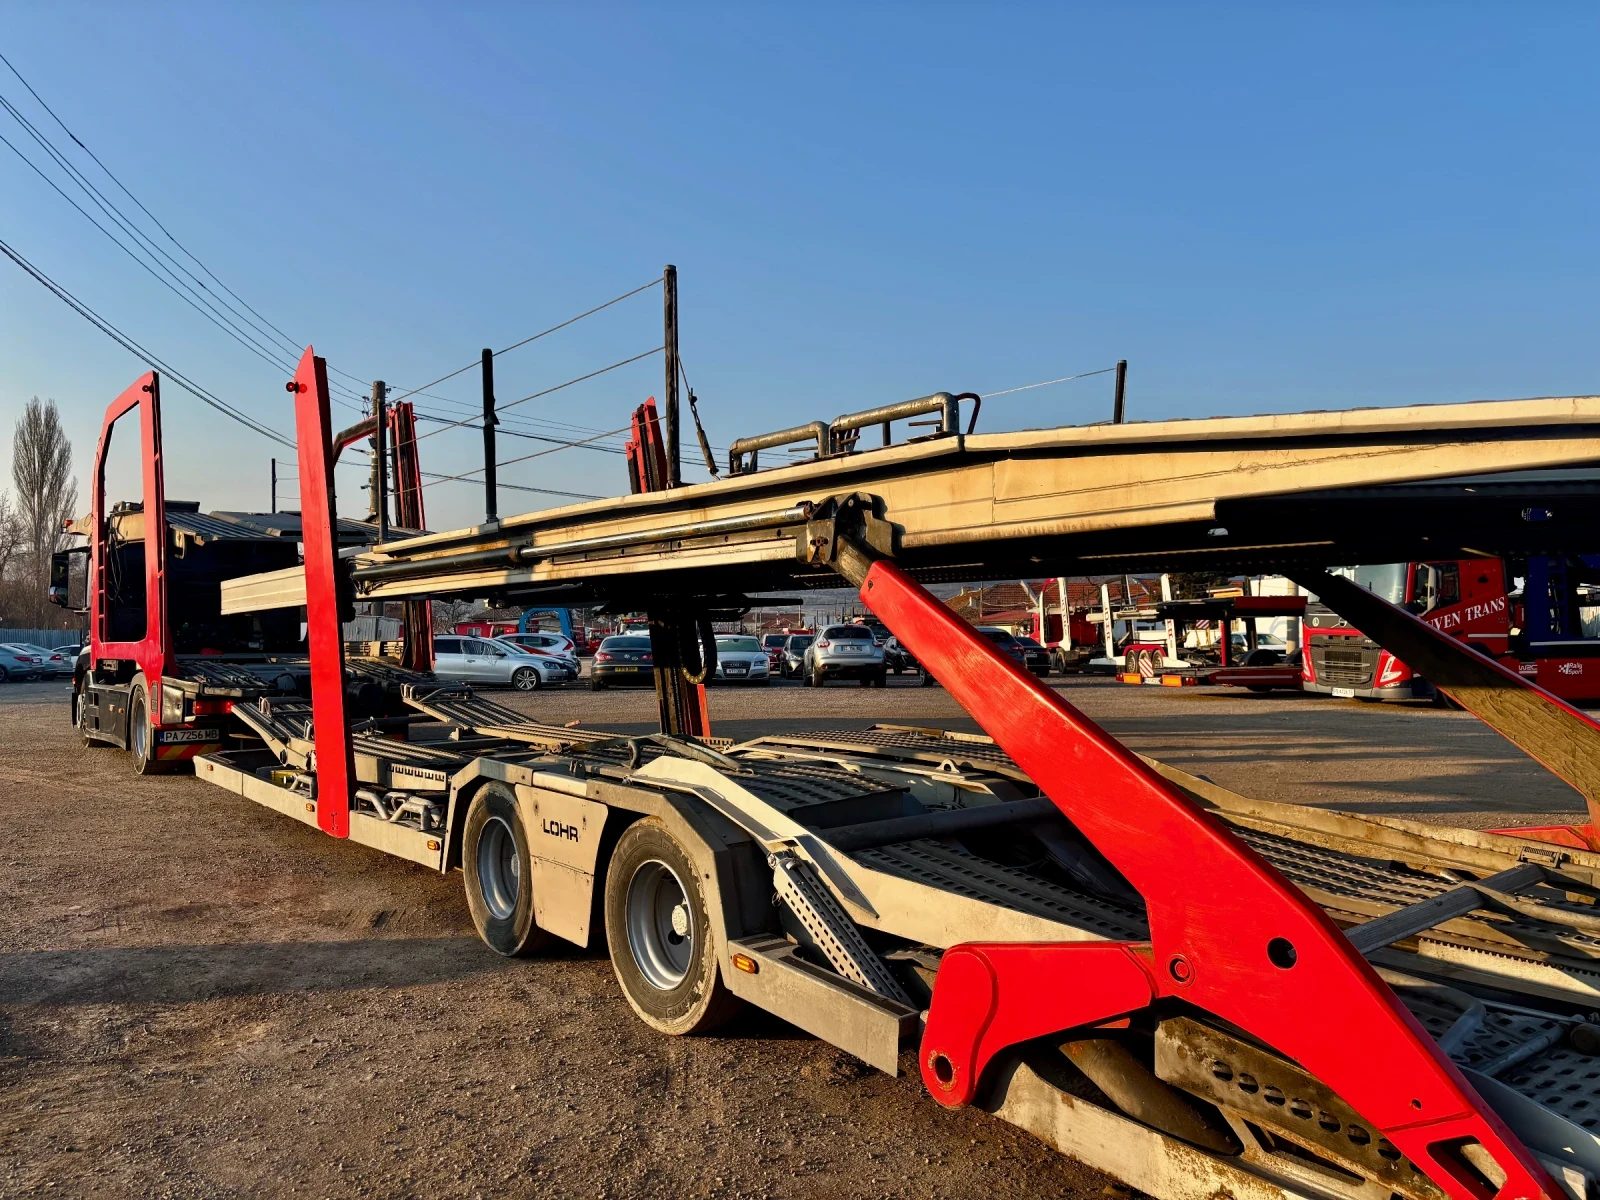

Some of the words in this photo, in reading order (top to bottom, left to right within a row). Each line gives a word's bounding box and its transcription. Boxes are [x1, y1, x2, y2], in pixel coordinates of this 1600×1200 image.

[1465, 596, 1505, 622] TRANS
[165, 731, 179, 741] PA
[180, 731, 203, 740] 7256
[542, 818, 579, 843] LOHR
